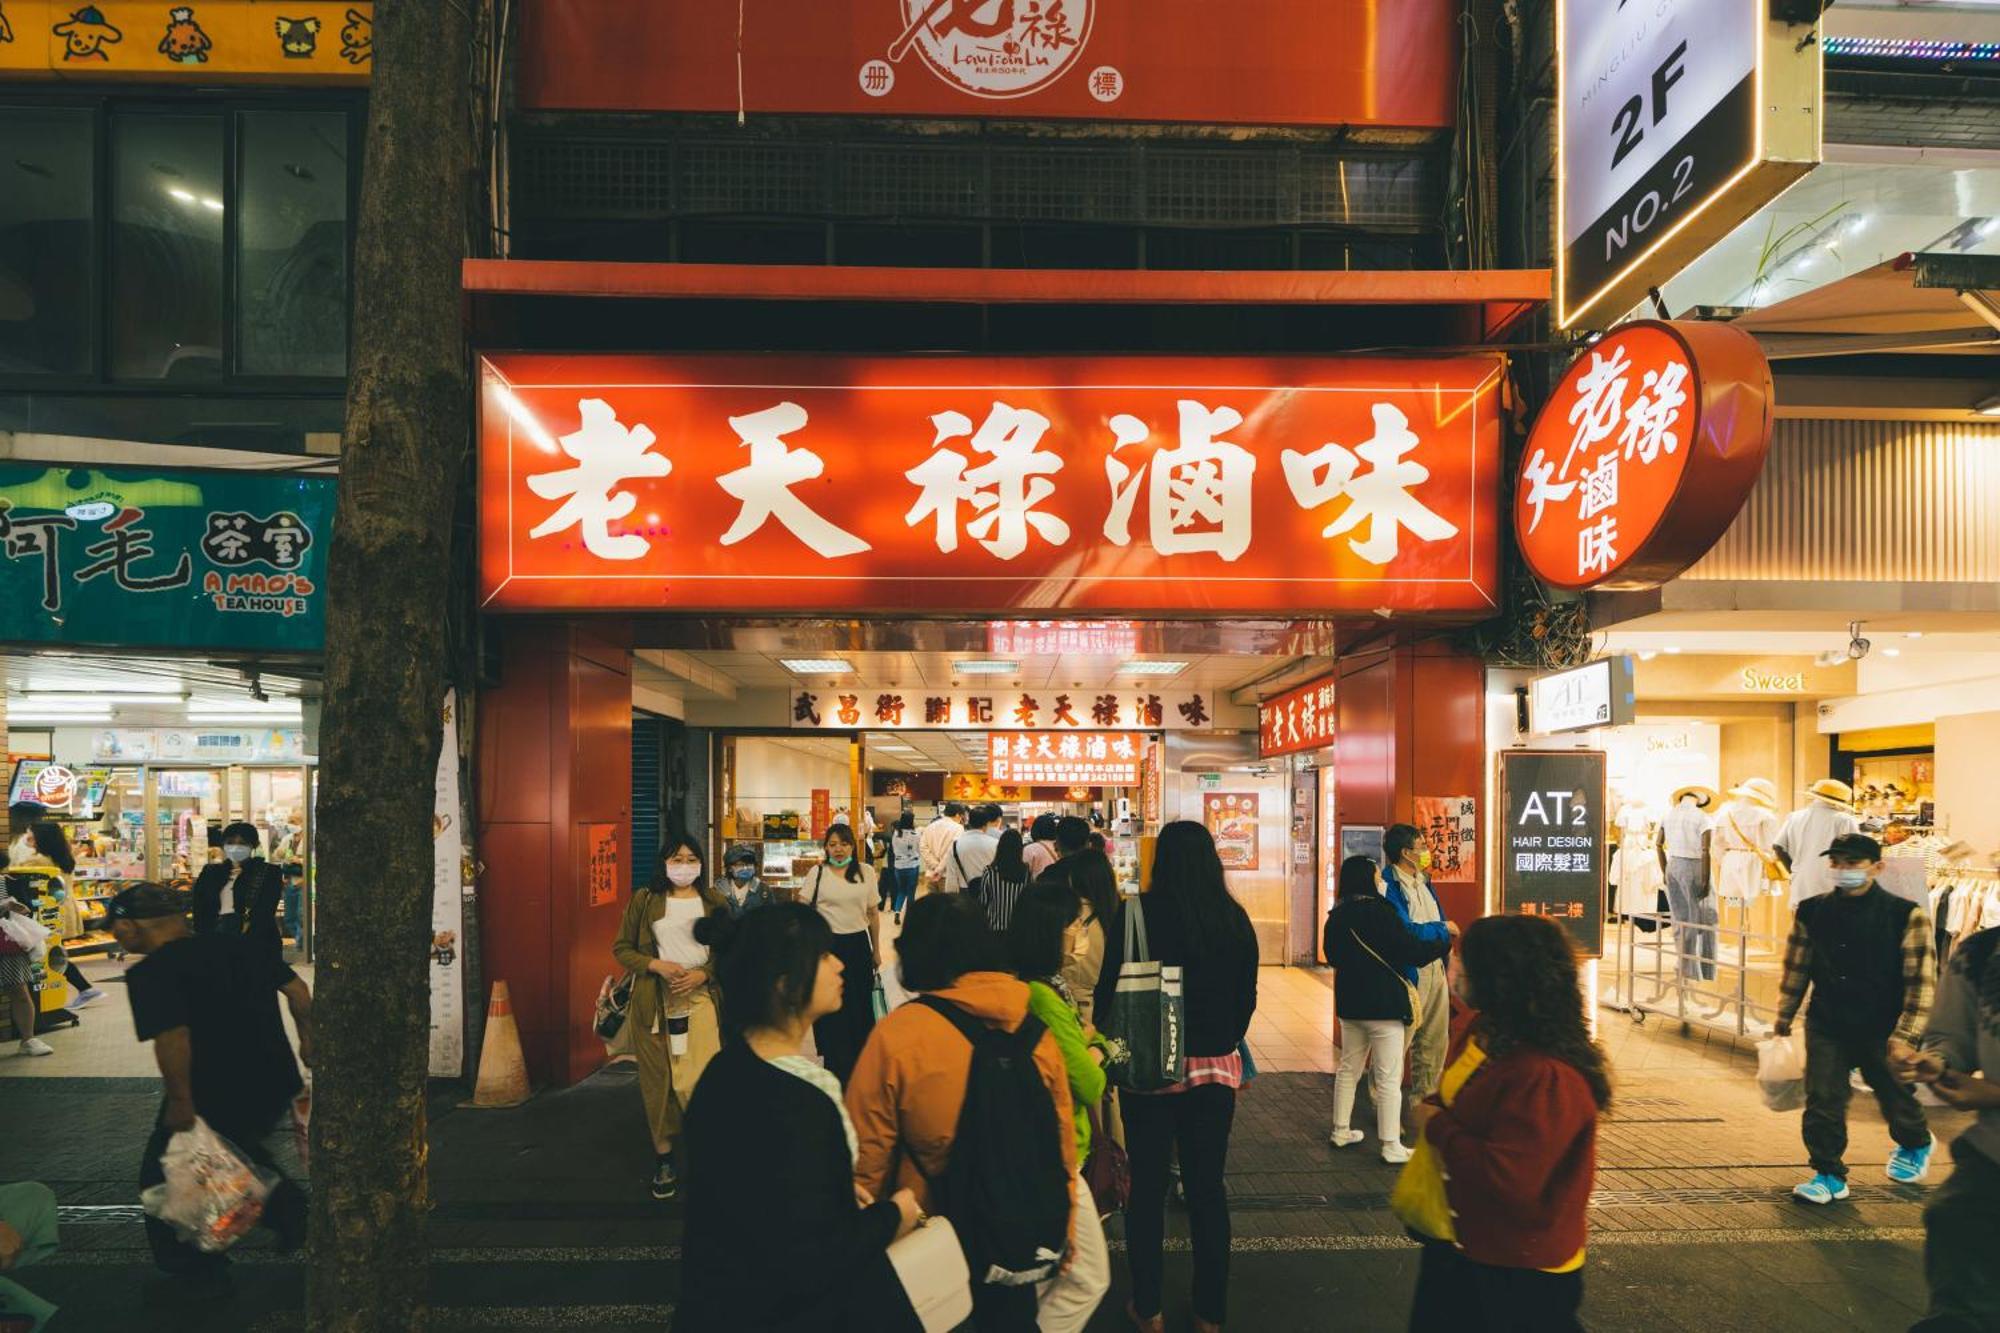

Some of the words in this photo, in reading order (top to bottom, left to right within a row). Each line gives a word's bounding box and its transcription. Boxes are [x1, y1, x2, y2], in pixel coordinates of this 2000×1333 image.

[1093, 72, 1117, 96] 標
[1610, 39, 1687, 171] 2F
[1606, 155, 1694, 261] NO.2
[527, 399, 1459, 563] 老天祿滷味
[1578, 450, 1619, 576] 滷味
[206, 515, 306, 565] 茶室
[205, 572, 222, 593] A
[1742, 668, 1807, 691] Sweet
[1012, 734, 1136, 759] 老天祿滷味
[1513, 836, 1542, 847] HAIR
[1547, 836, 1592, 847] DESIGN
[1516, 852, 1590, 872] 國際髮型
